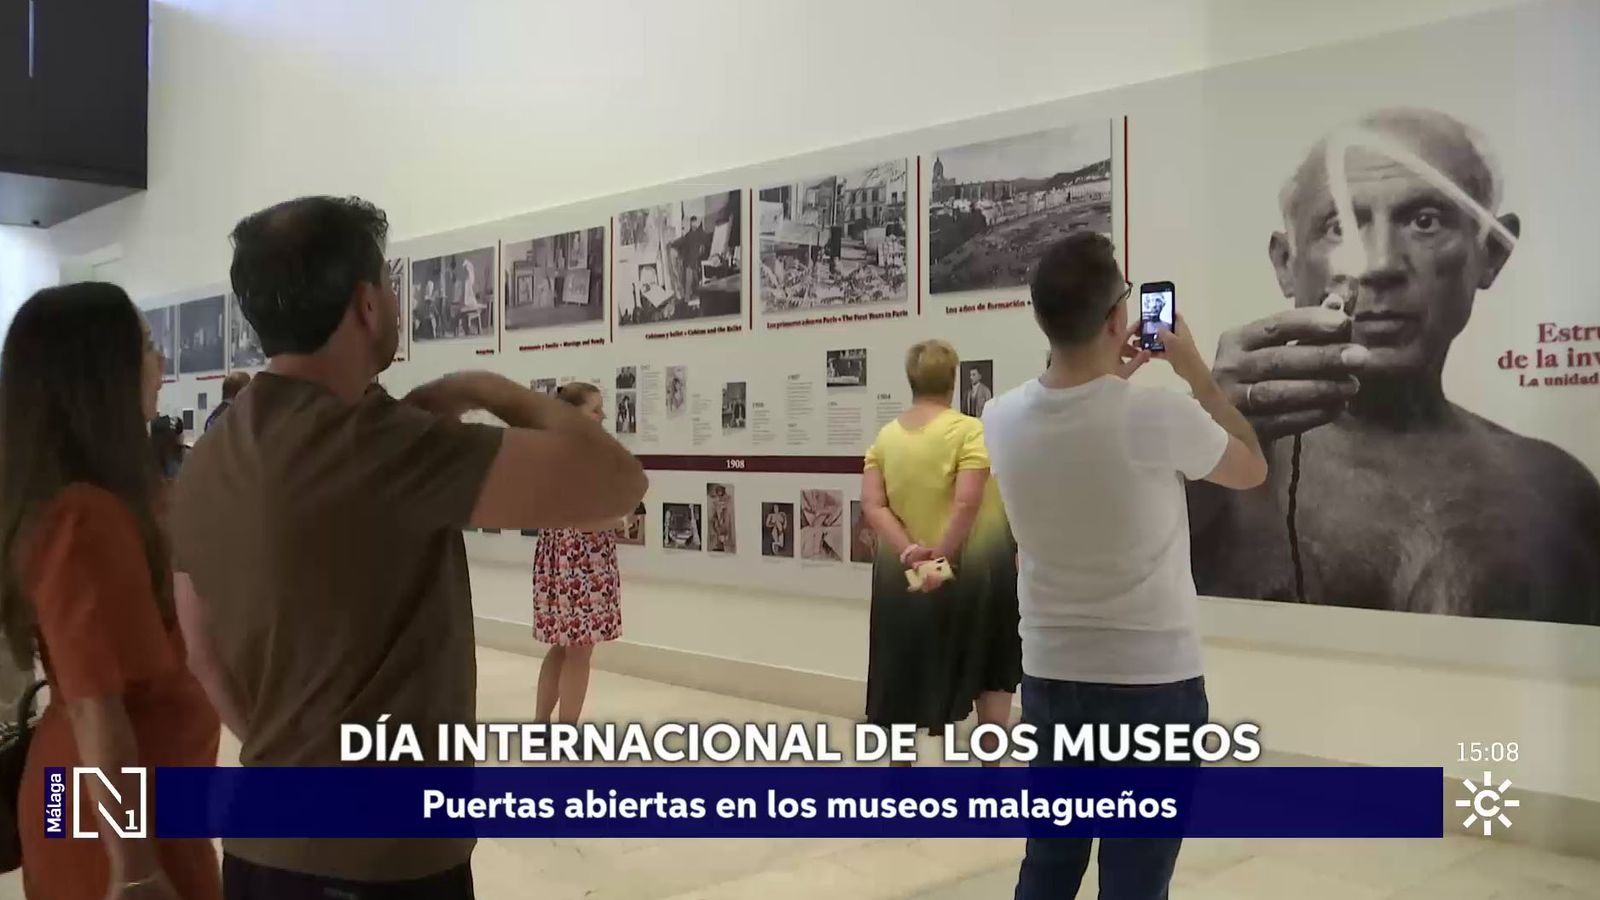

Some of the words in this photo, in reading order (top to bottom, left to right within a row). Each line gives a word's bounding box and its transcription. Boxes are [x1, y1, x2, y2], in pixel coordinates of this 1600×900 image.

[977, 302, 985, 311] de
[1537, 322, 1600, 344] Estr
[1497, 349, 1529, 369] de
[1536, 348, 1559, 368] la
[1567, 347, 1600, 367] inv
[1519, 373, 1540, 387] La
[1544, 371, 1600, 386] unidad
[726, 458, 746, 470] 1908
